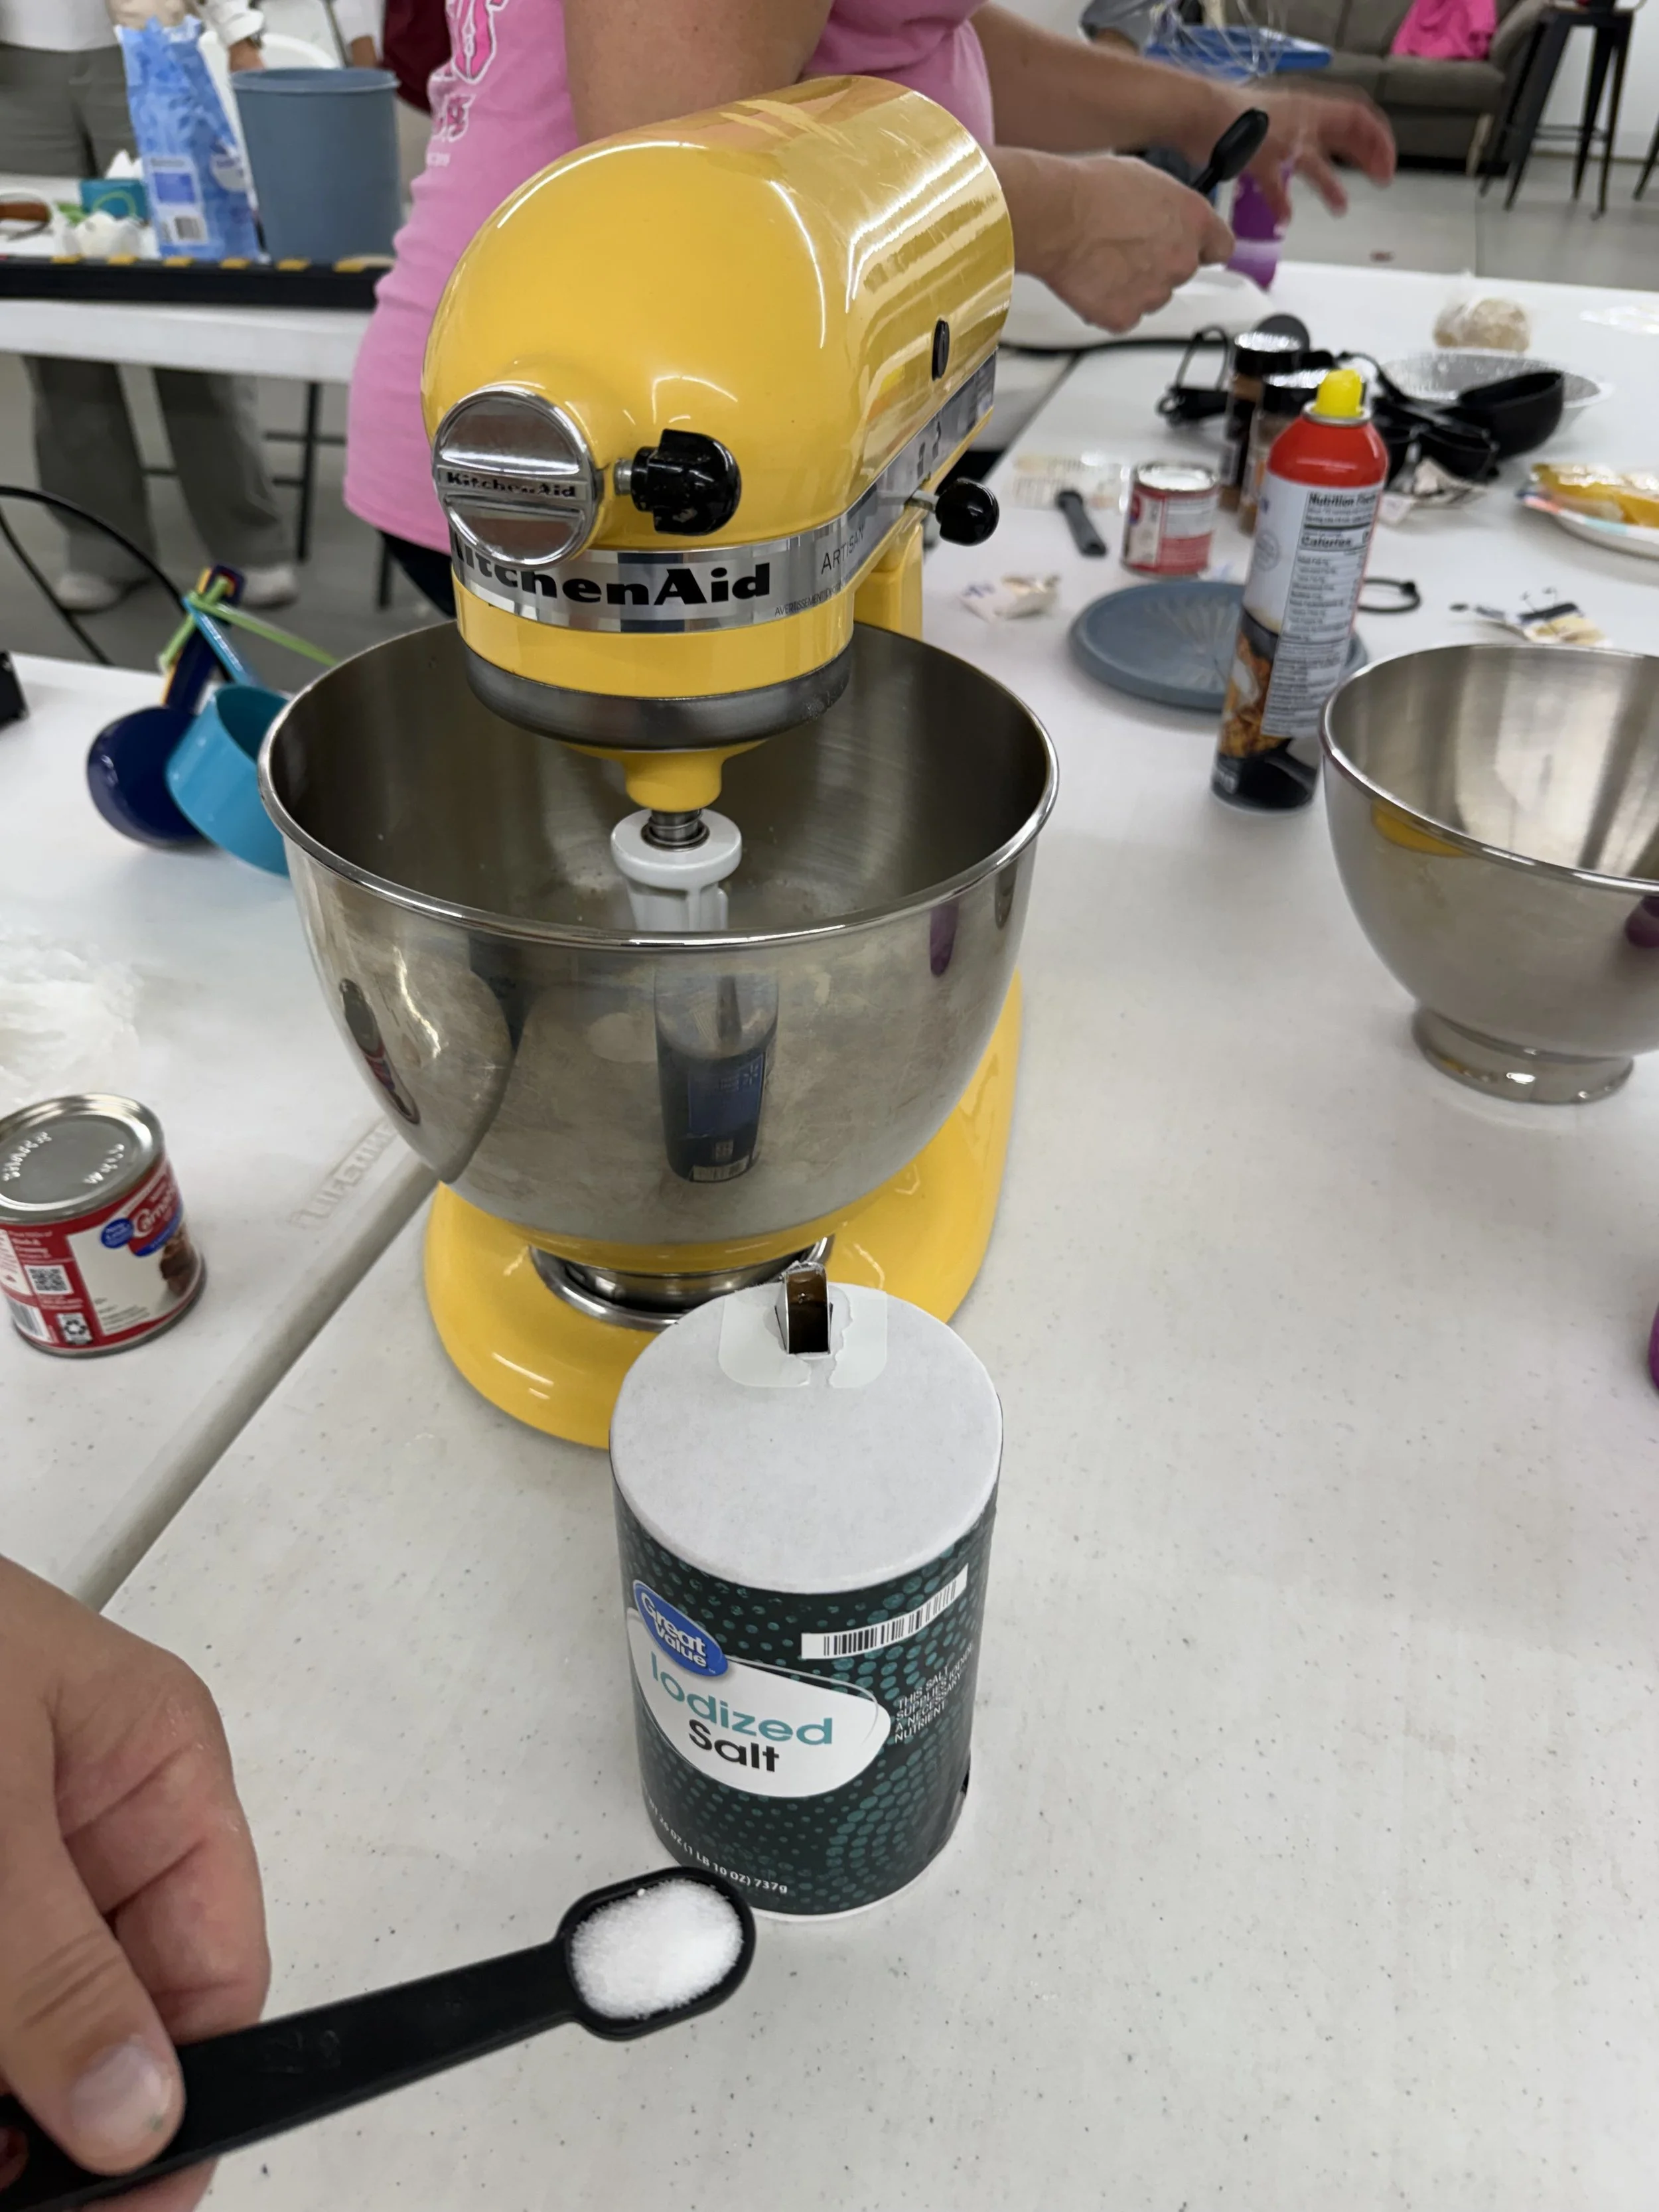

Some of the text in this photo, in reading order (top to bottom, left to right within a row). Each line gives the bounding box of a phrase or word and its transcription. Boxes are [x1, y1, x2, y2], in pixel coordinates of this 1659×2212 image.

[447, 472, 575, 496] KitchenAid
[1309, 492, 1354, 506] Nutrition
[455, 535, 770, 605] itchenAid
[822, 524, 863, 575] ARTISAN
[642, 1592, 707, 1657] Great
[654, 1617, 707, 1668] Value
[650, 1651, 832, 1745] Iodized
[897, 1677, 947, 1720] SUPPLIES
[899, 1666, 948, 1710] THIS SALT
[689, 1719, 779, 1773] Salt
[895, 1700, 945, 1744] NUTRIENT
[895, 1722, 903, 1733] A
[670, 1828, 684, 1846] OZ
[684, 1842, 693, 1856] (1
[696, 1851, 711, 1867] LB
[713, 1862, 727, 1877] 10
[730, 1871, 751, 1887] OZ)
[754, 1878, 788, 1895] 737g
